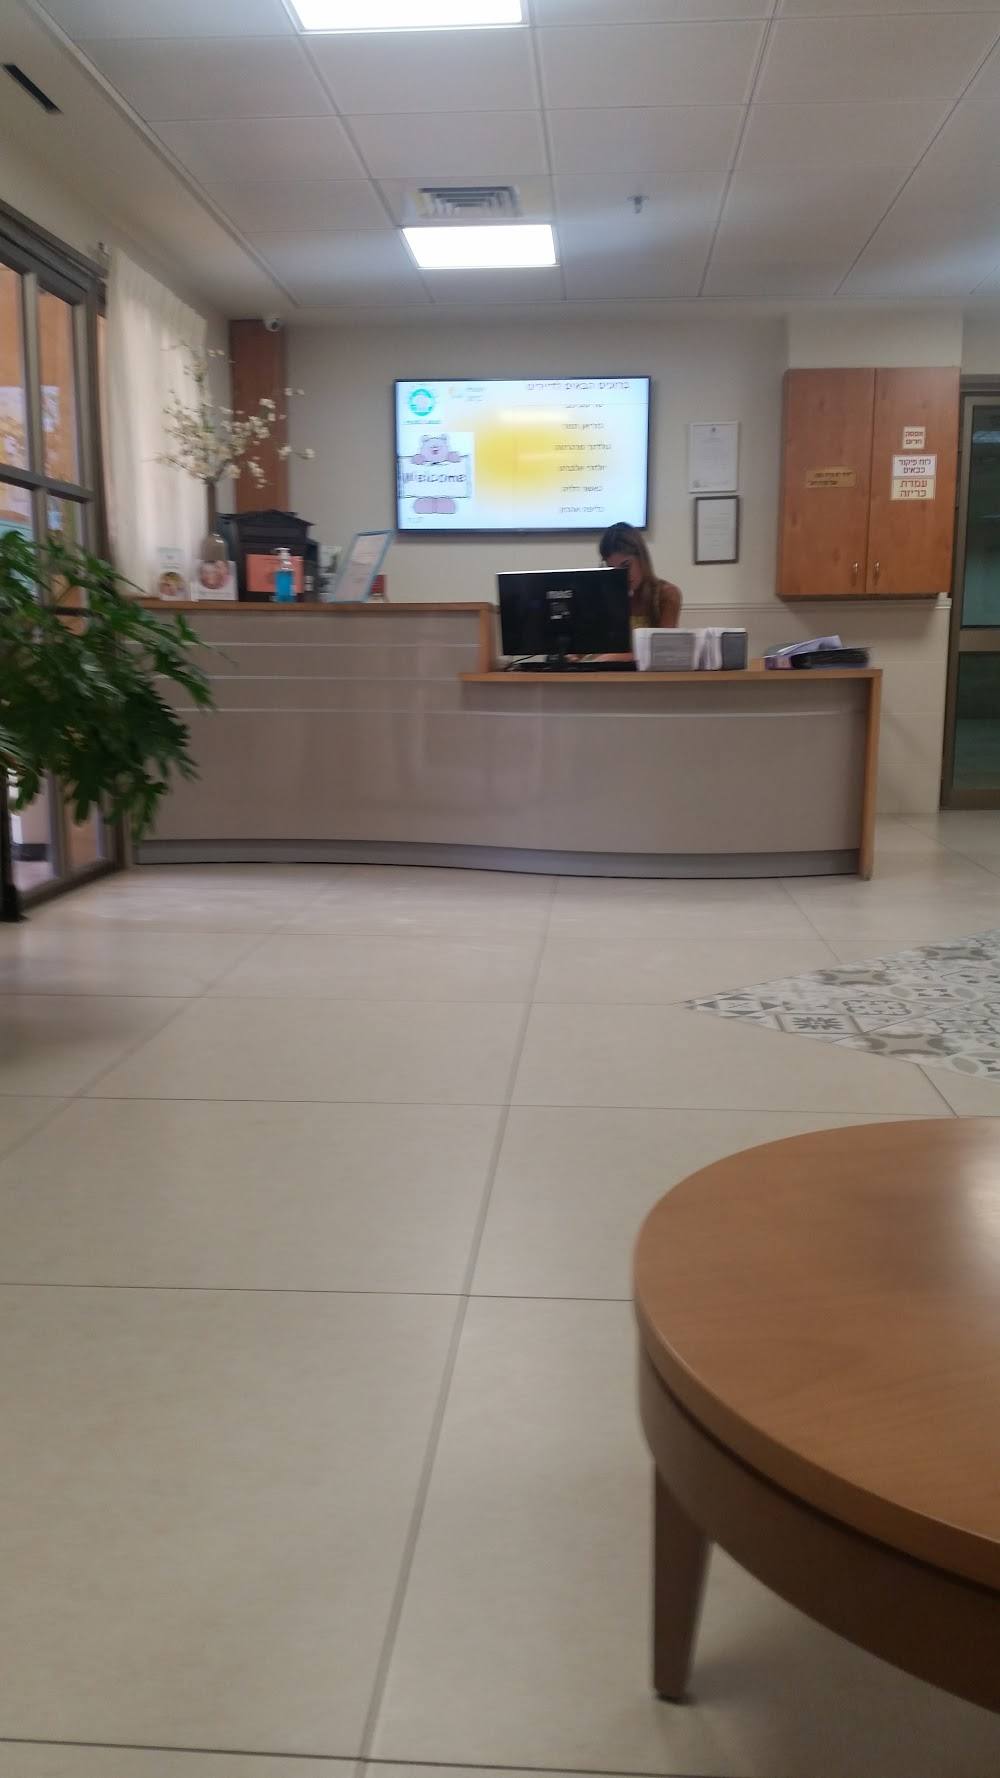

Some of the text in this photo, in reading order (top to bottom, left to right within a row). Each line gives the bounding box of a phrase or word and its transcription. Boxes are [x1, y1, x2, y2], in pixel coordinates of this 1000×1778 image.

[898, 457, 932, 467] לוח פיקוד
[903, 466, 926, 474] כבאים
[899, 480, 928, 488] עמדת
[900, 489, 927, 498] כריזה
